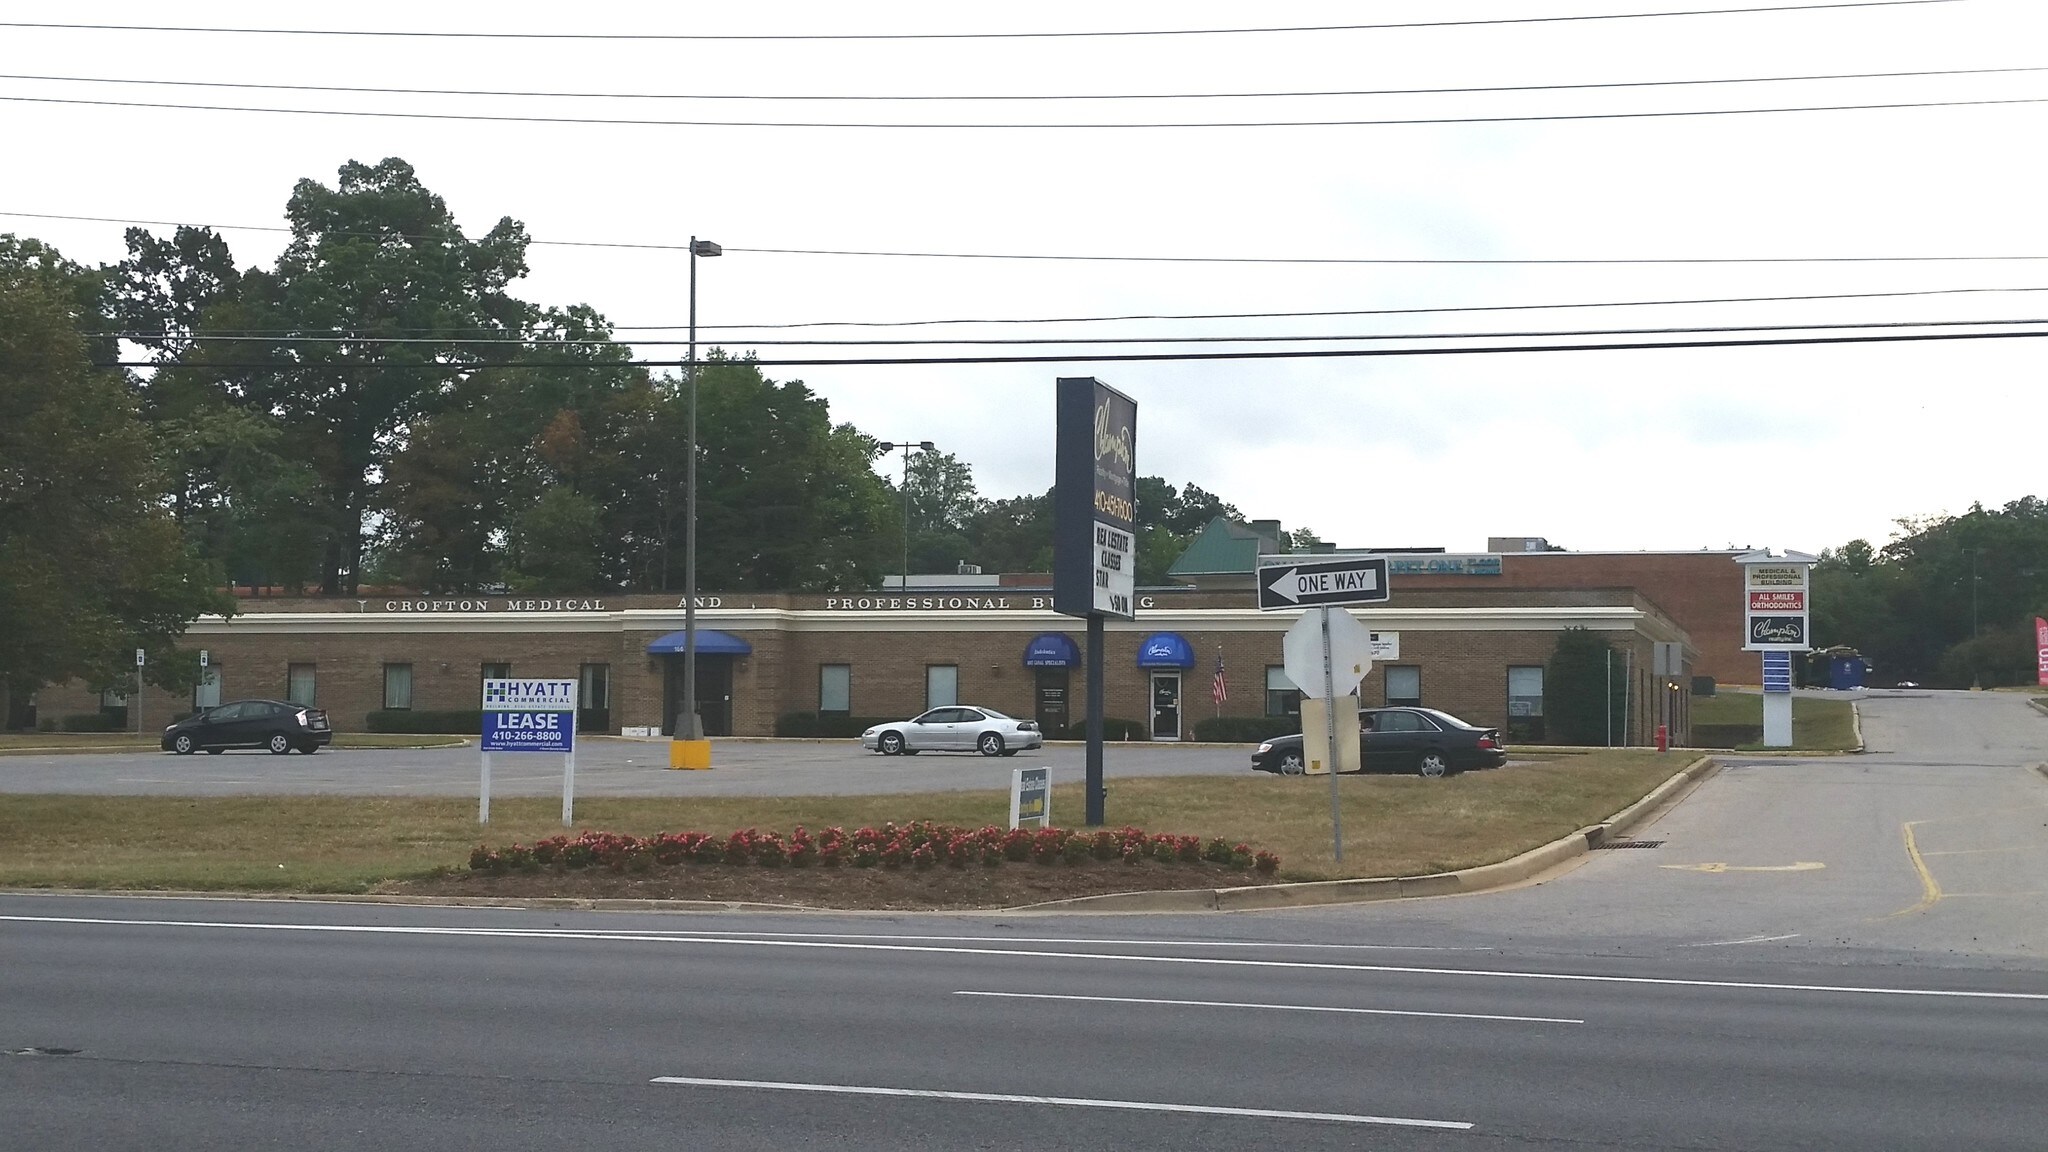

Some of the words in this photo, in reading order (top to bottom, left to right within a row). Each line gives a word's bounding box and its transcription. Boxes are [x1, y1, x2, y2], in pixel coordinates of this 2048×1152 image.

[1298, 575, 1329, 593] ONE
[1334, 571, 1367, 590] WAY
[386, 600, 489, 611] CROFTON
[507, 600, 605, 611] MEDICAL
[677, 597, 722, 608] AND
[826, 598, 1012, 609] PROFESSIONAL
[1758, 593, 1770, 601] ALL
[1772, 593, 1795, 601] SMILES
[1753, 618, 1801, 638] Champion
[508, 682, 572, 696] HYATT
[497, 713, 559, 729] LEASE
[492, 731, 562, 741] 410-266-8800
